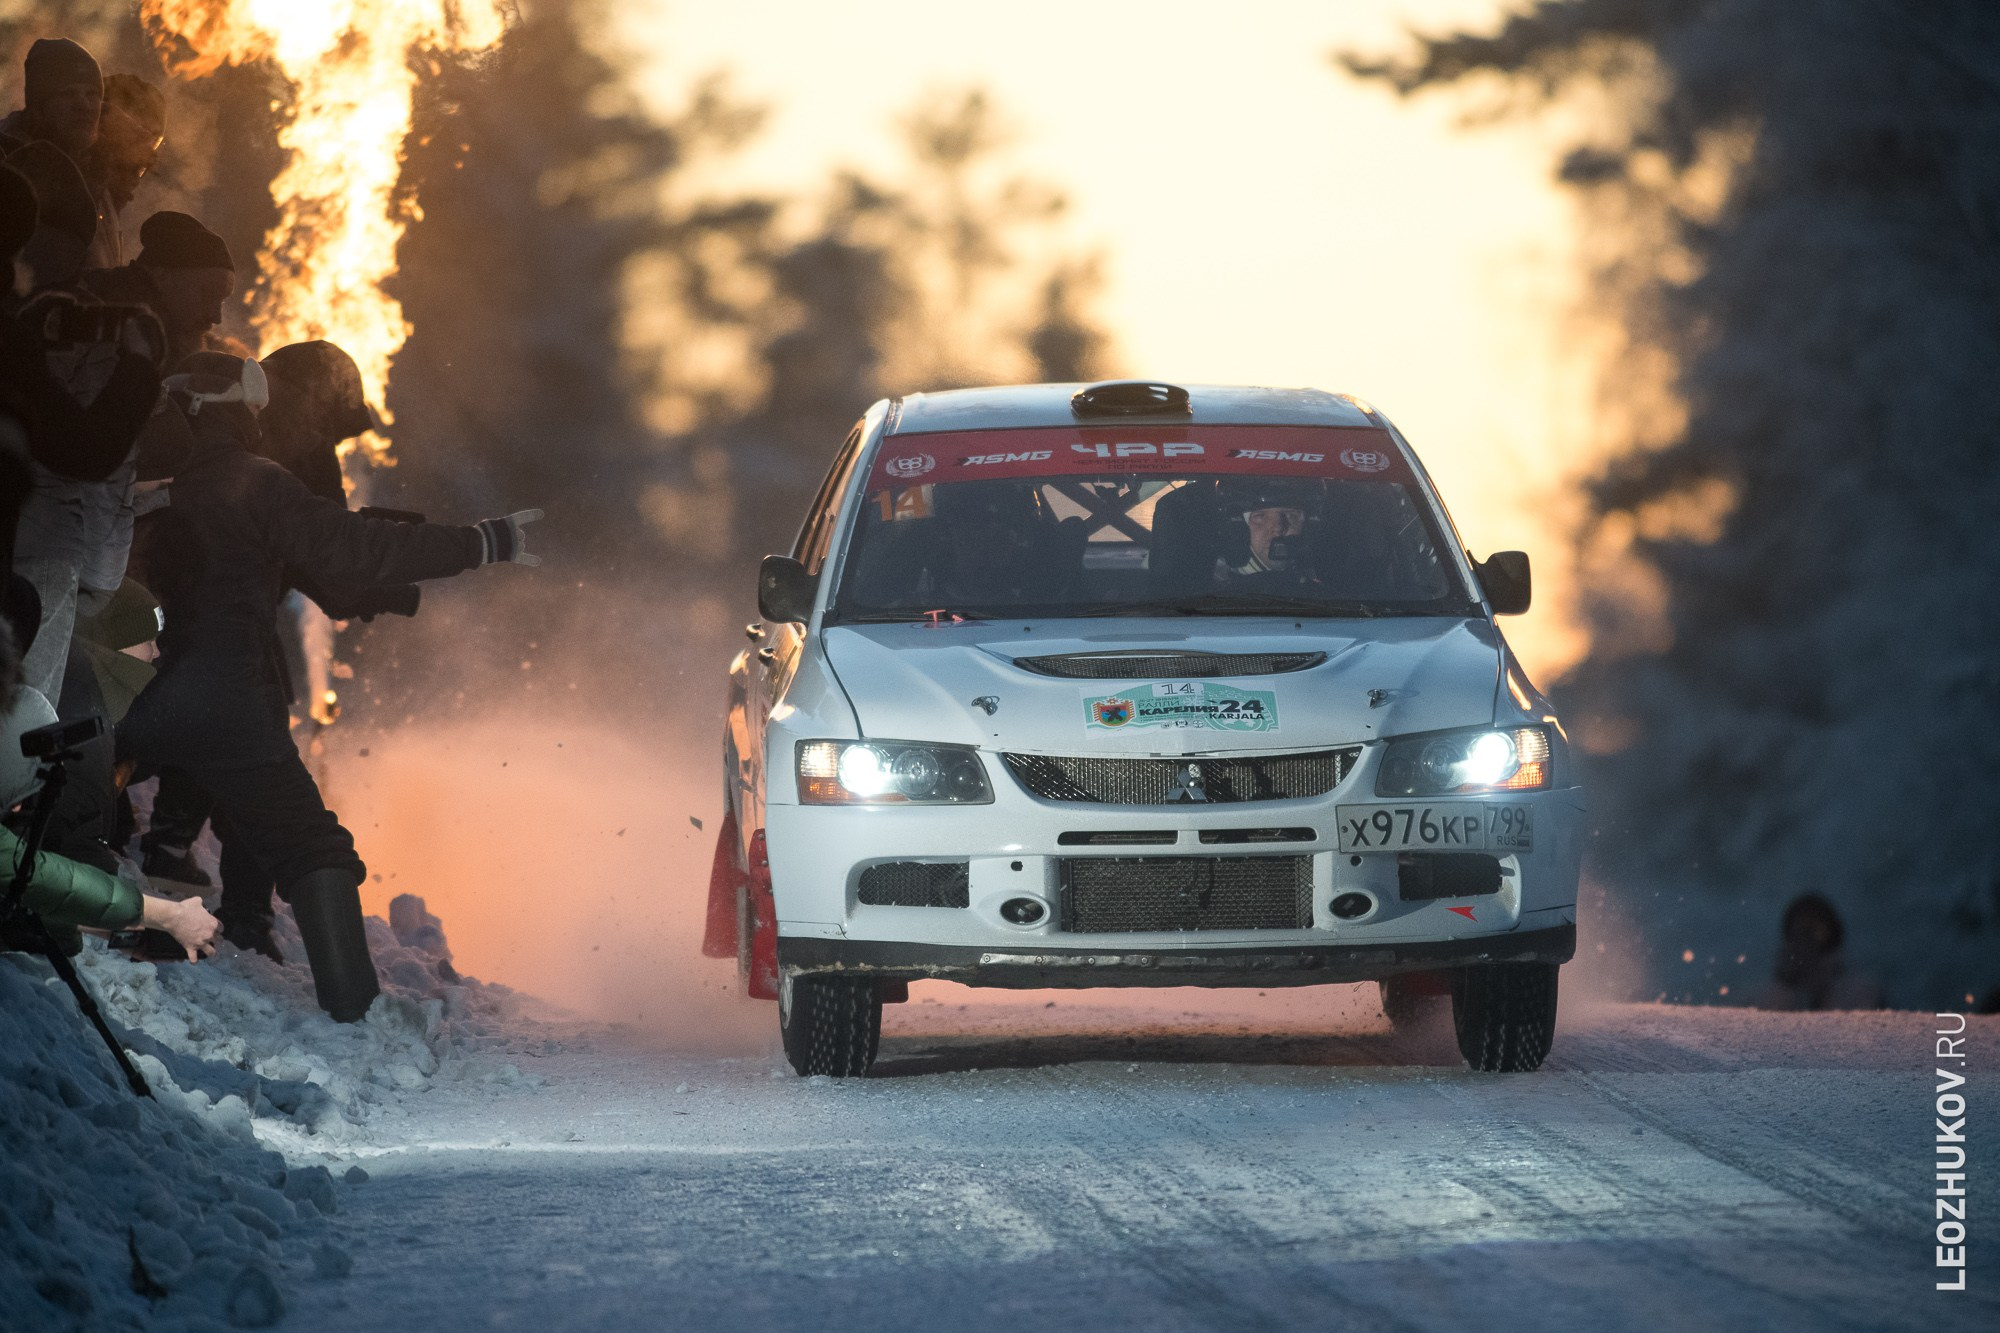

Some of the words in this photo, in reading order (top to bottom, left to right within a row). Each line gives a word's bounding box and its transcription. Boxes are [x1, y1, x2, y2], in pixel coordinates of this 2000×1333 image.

[963, 450, 1053, 466] ASMG
[1234, 449, 1325, 463] ASMG
[872, 484, 925, 522] 14
[1161, 683, 1195, 695] 14
[1138, 700, 1180, 709] РАЛЛИ
[1139, 705, 1218, 716] КАРЕЛИЯ
[1486, 806, 1526, 835] 799
[1497, 835, 1517, 846] RUS
